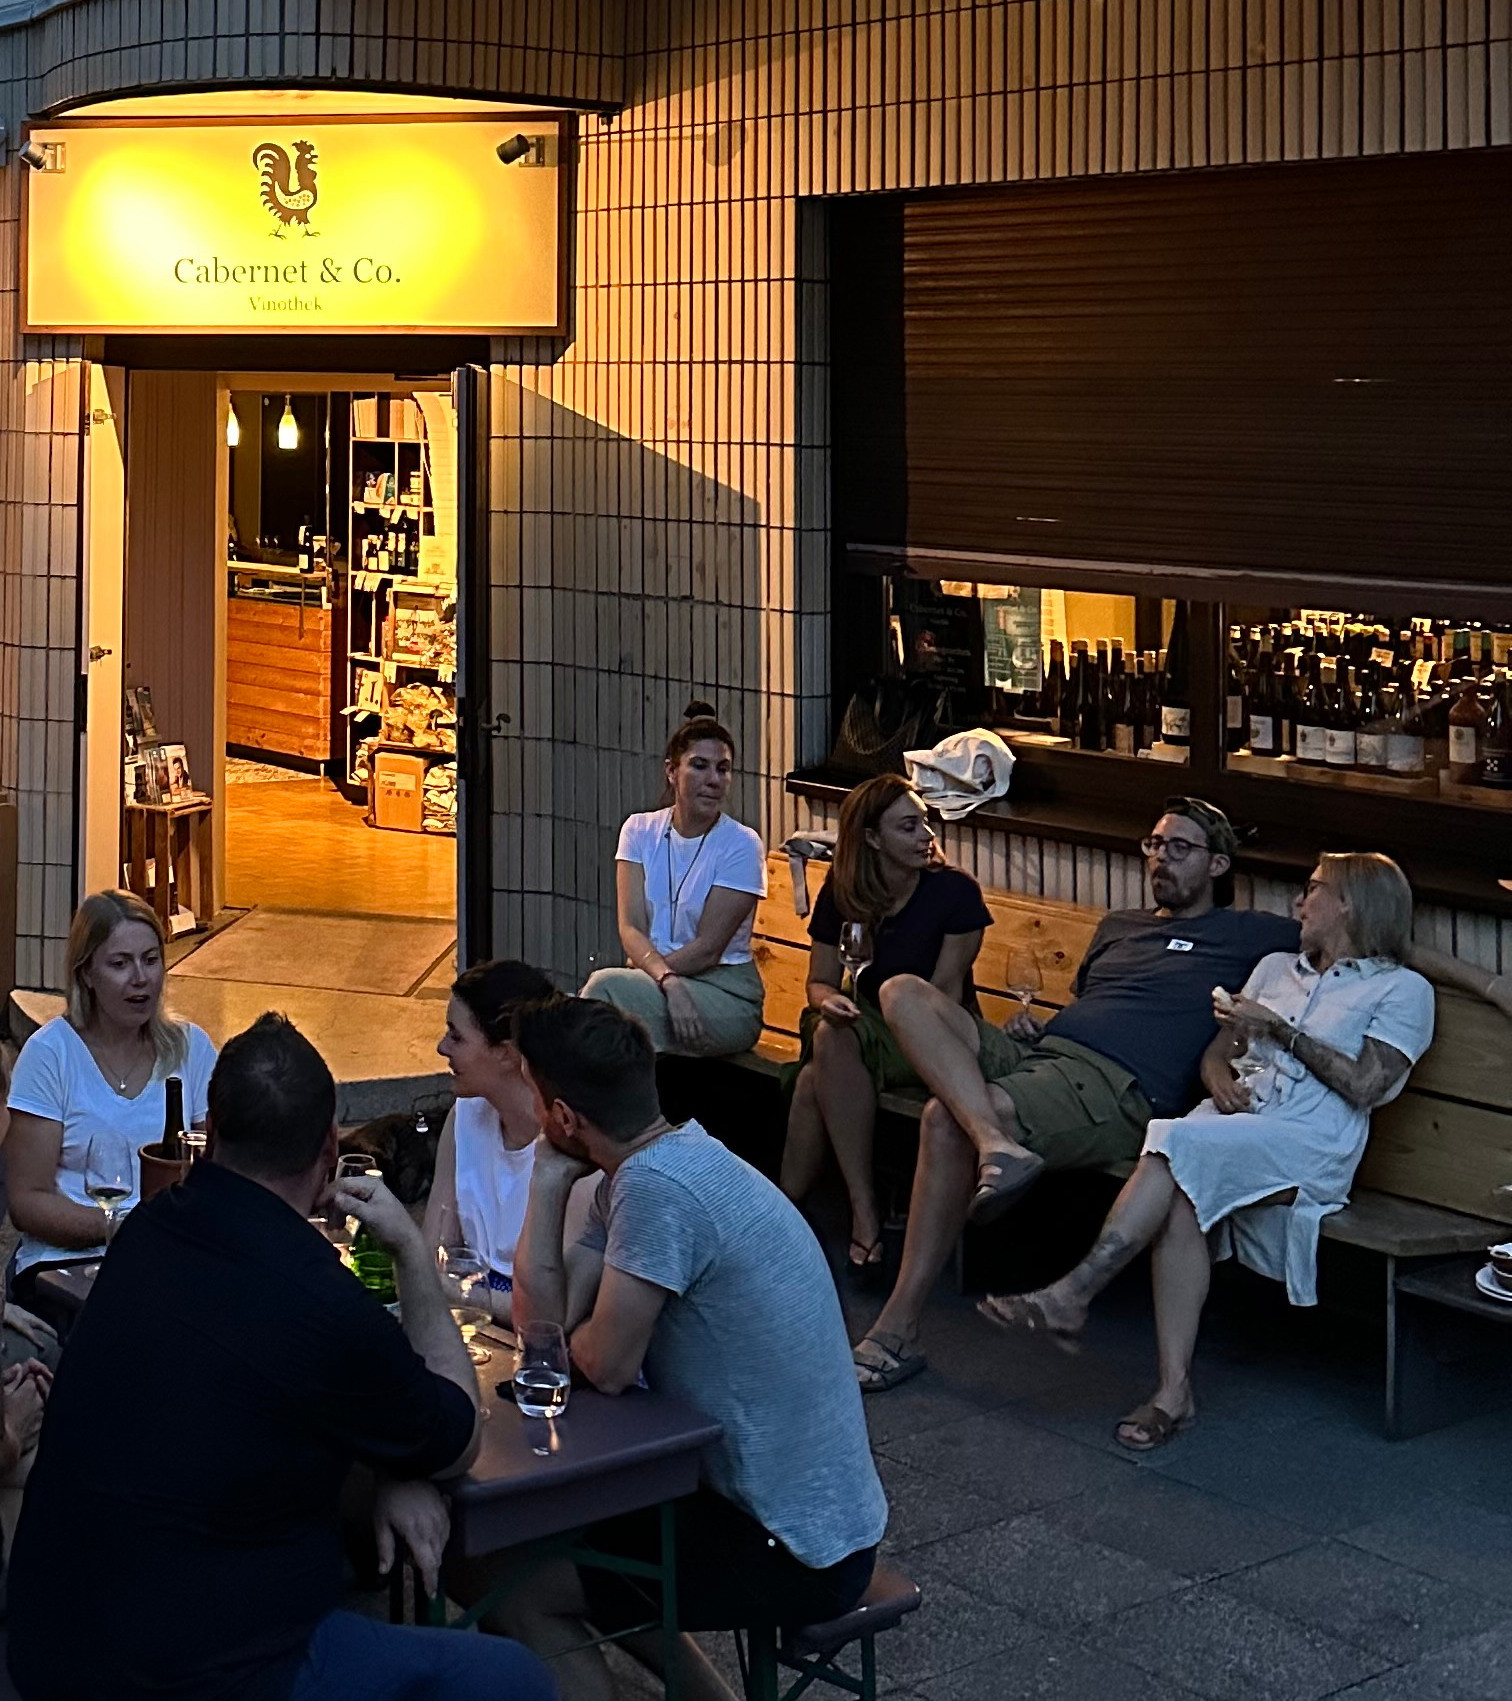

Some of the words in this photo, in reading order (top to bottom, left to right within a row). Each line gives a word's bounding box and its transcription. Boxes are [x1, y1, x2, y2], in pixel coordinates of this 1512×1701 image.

[174, 256, 308, 284] Cabernet
[320, 257, 343, 283] &
[353, 257, 402, 284] Co.
[249, 295, 323, 311] Vinothek
